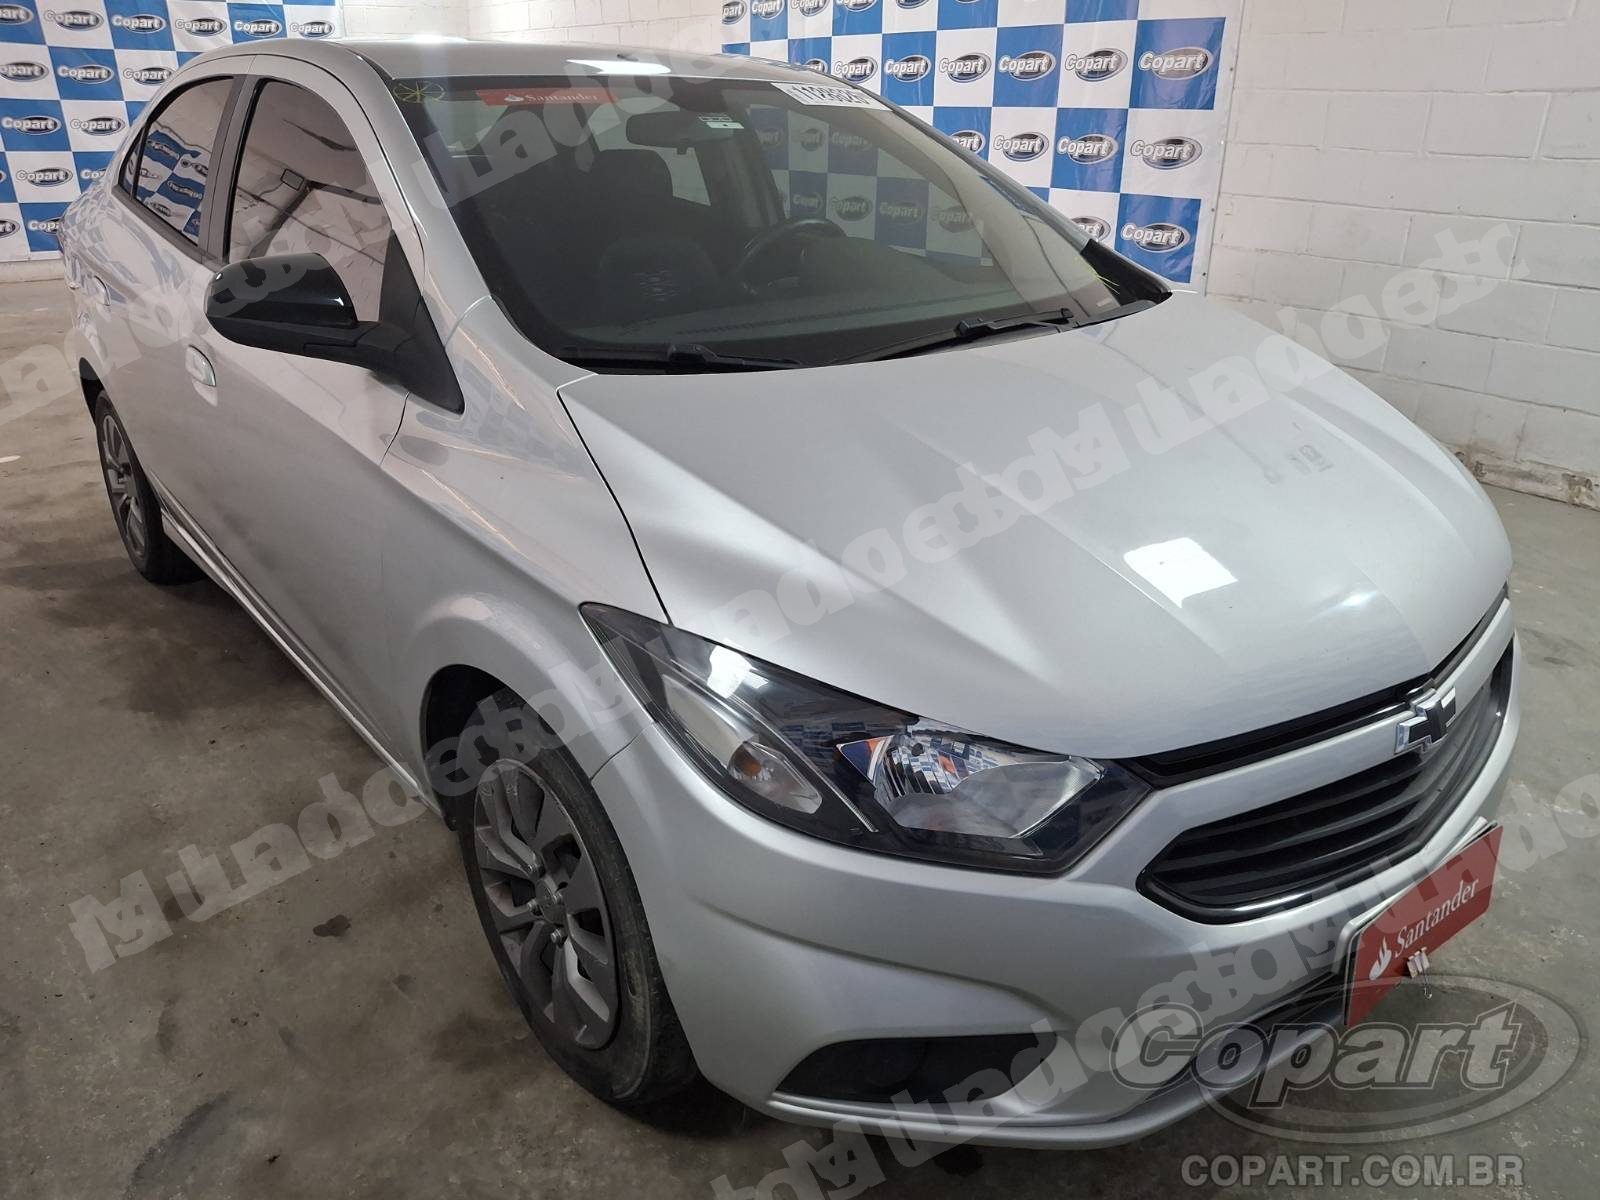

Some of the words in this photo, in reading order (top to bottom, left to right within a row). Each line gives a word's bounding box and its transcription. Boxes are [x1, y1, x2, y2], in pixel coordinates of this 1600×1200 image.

[751, 0, 780, 15] Copart
[44, 10, 97, 28] Copart
[112, 15, 162, 29] Copart
[175, 19, 220, 34] Copart
[234, 20, 277, 34] Copart
[290, 22, 331, 35] Copart
[833, 60, 872, 76] Copart
[884, 58, 926, 77] Copart
[938, 57, 984, 77] Copart
[999, 55, 1048, 76] Copart
[1064, 53, 1118, 75] Copart
[1138, 51, 1205, 74] Copart
[58, 66, 108, 82] Copart
[123, 68, 170, 83] Copart
[524, 93, 598, 103] Santander
[2, 117, 57, 133] Copart
[70, 118, 120, 133] Copart
[993, 135, 1042, 154] Copart
[1057, 136, 1110, 156] Copart
[1130, 139, 1193, 161] Copart
[16, 170, 68, 183] Copart
[1121, 223, 1181, 245] Copart
[1395, 878, 1479, 958] Santander
